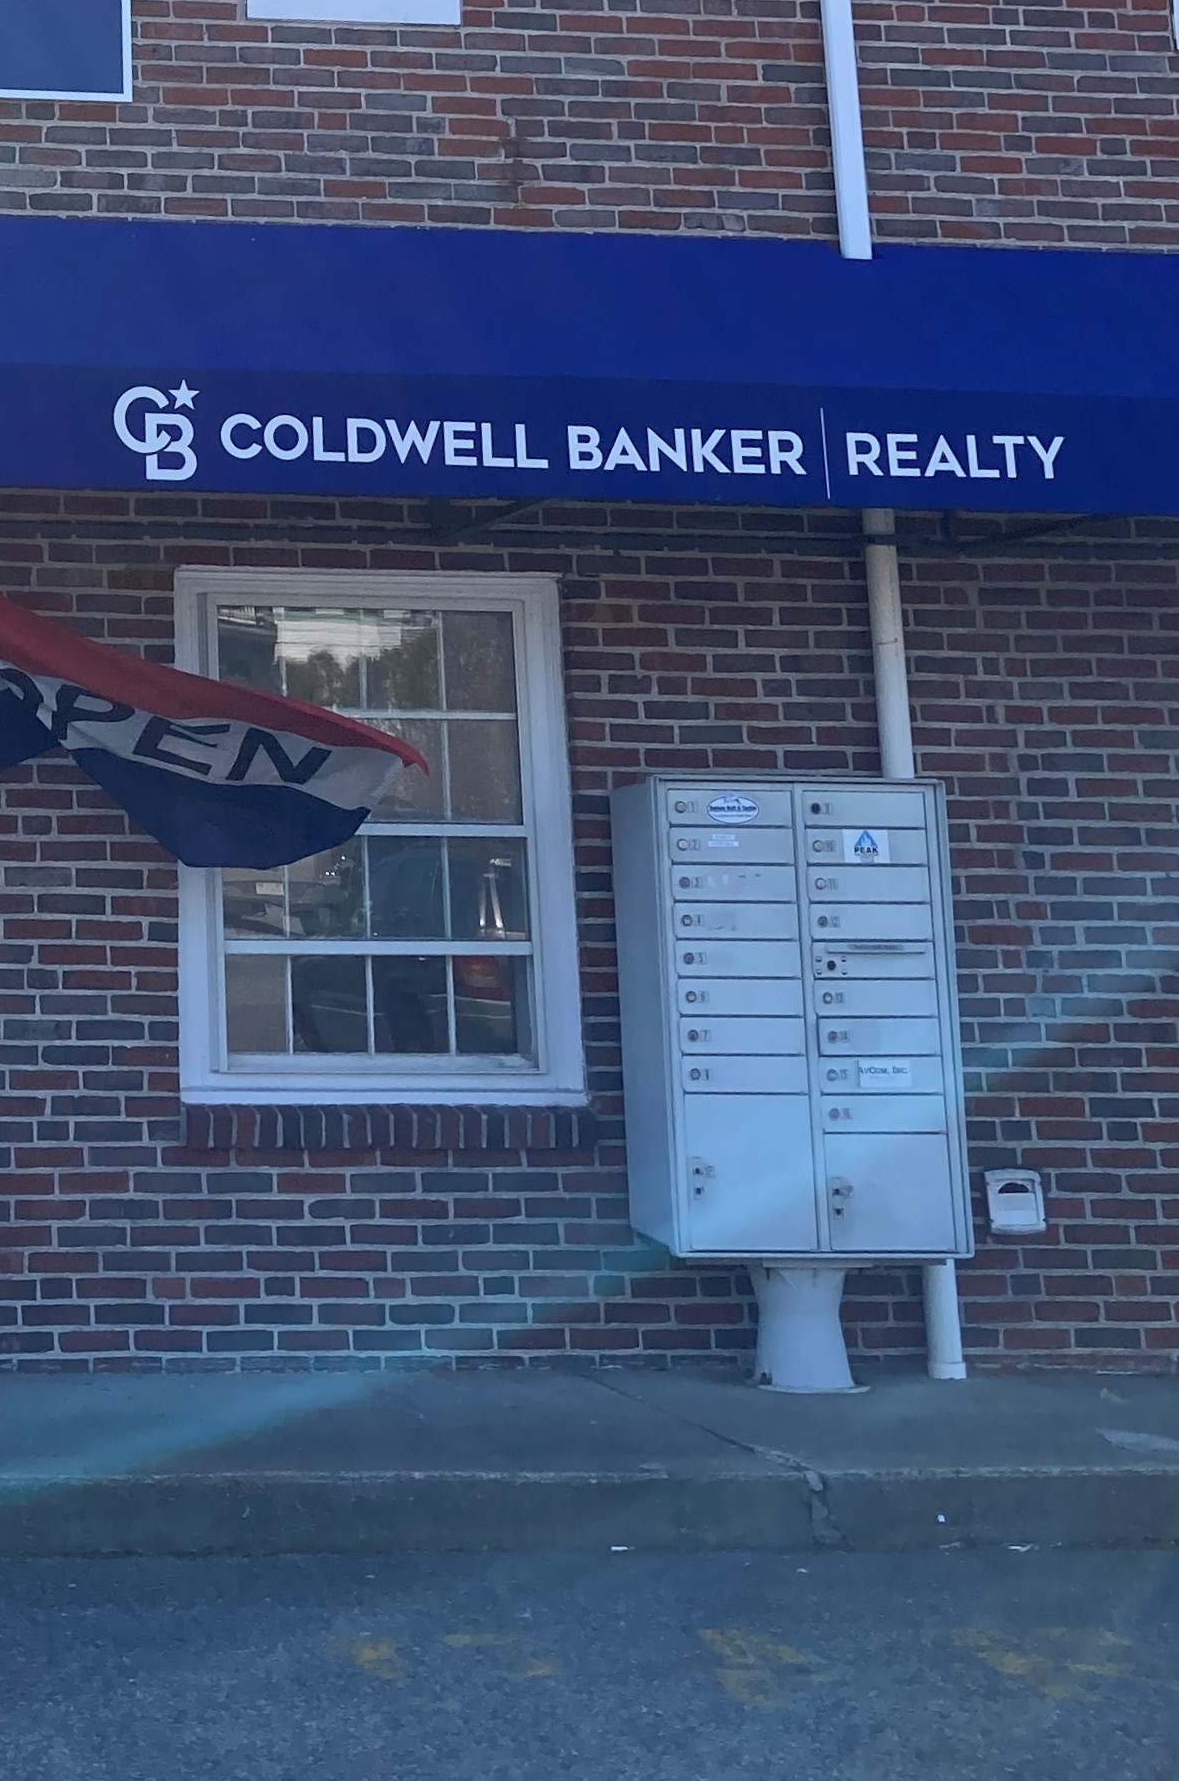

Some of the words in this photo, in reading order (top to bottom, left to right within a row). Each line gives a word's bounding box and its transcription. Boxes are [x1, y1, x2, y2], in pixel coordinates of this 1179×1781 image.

[113, 385, 198, 481] CB
[220, 412, 549, 470] COLDWELL
[567, 424, 808, 476] BANKER
[846, 431, 1065, 480] REALTY
[854, 846, 879, 854] PEAK
